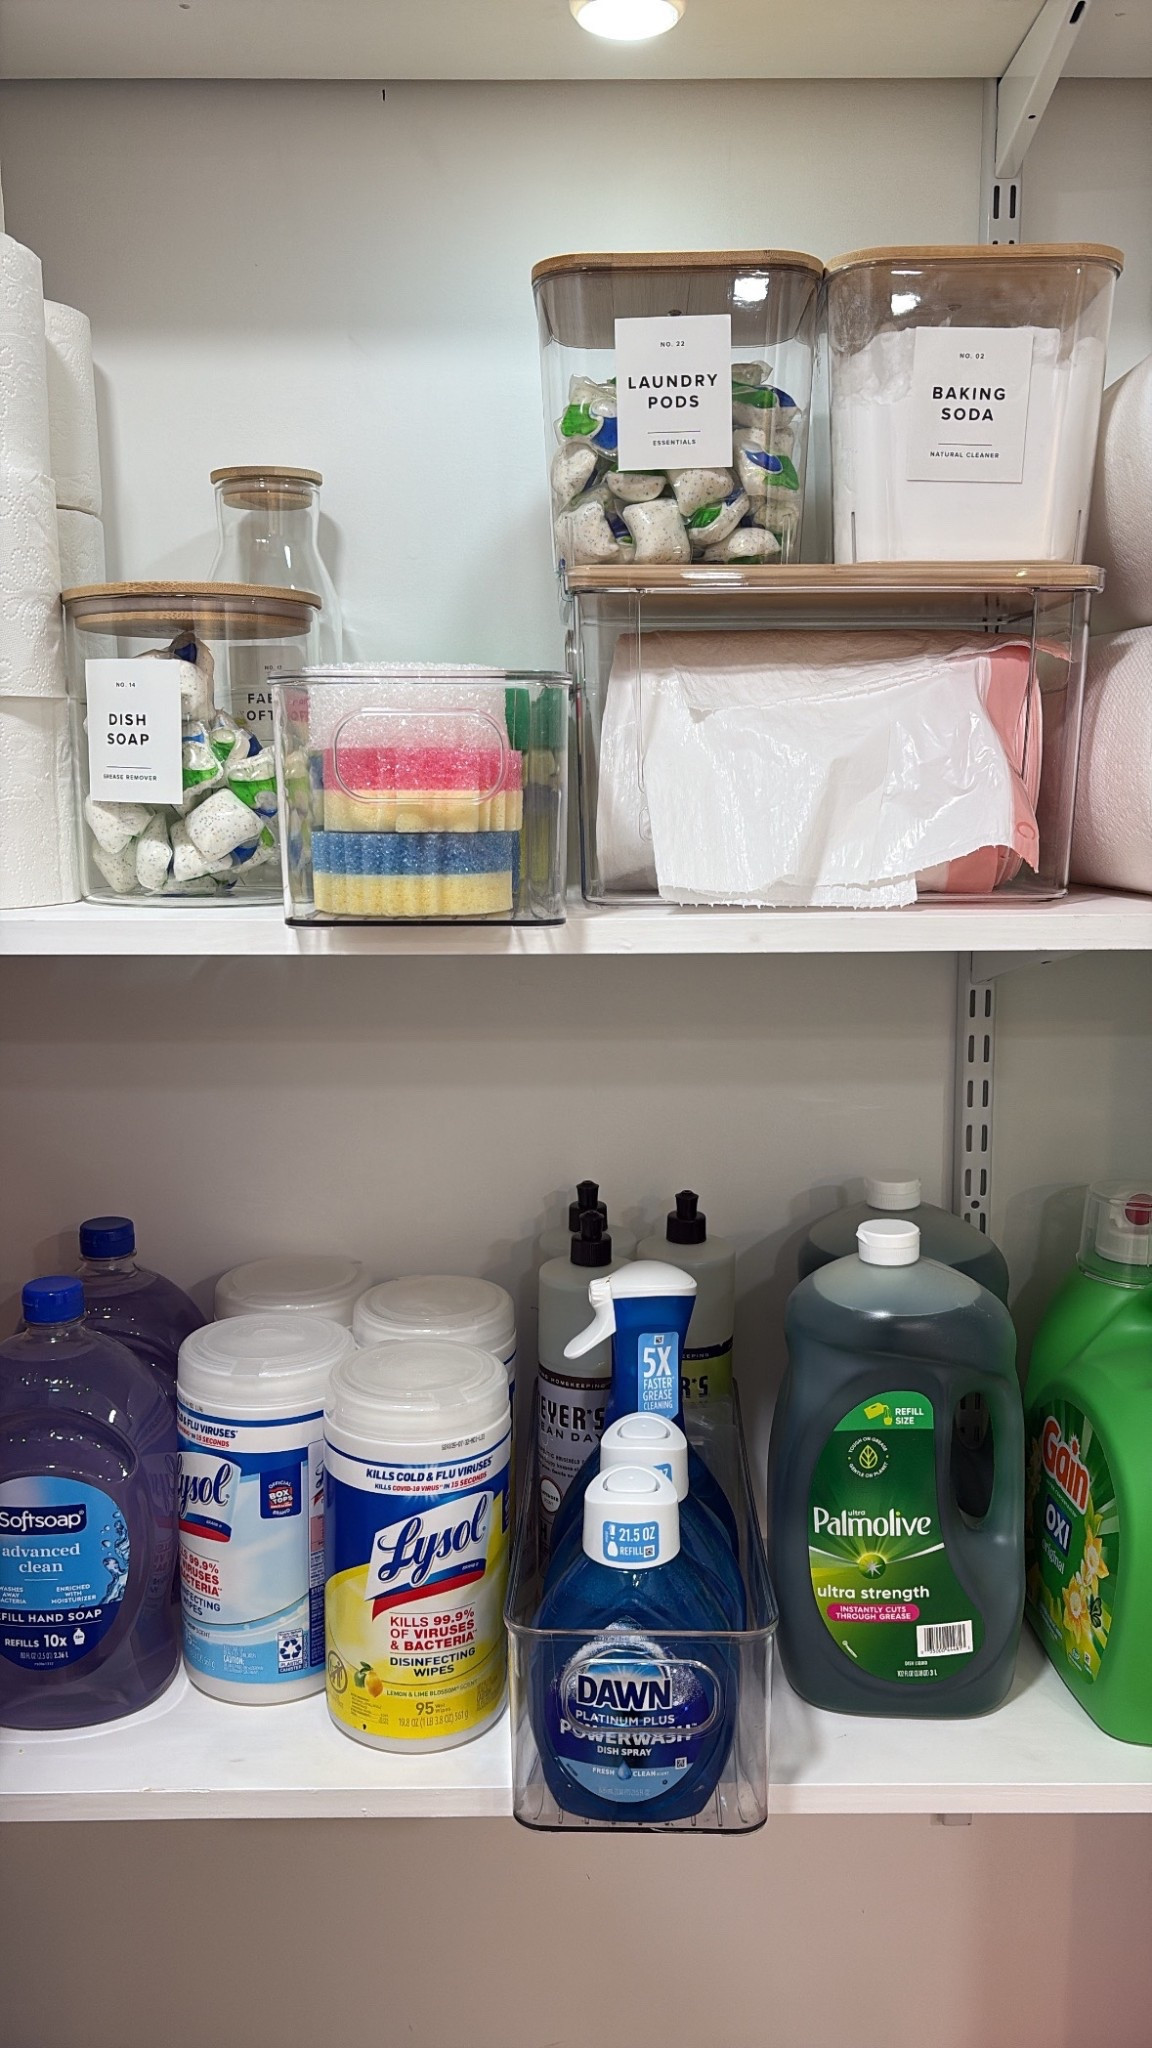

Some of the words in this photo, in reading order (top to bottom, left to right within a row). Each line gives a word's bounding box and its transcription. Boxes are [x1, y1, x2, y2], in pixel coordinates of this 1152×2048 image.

[628, 374, 718, 389] LAUNDRY
[932, 386, 1006, 401] BAKING
[648, 395, 700, 409] PODS
[941, 408, 994, 421] SODA
[108, 713, 147, 726] DISH
[107, 733, 150, 746] SOAP
[642, 1346, 671, 1377] 5X
[643, 1378, 672, 1388] FASTER
[643, 1390, 672, 1400] GREASE
[644, 1400, 673, 1410] CLEANING
[895, 1408, 924, 1416] REFILL
[895, 1417, 914, 1425] SIZE
[187, 1419, 200, 1431] FLU
[200, 1424, 236, 1438] VIRUSES
[203, 1436, 229, 1447] SECONDS
[848, 1438, 862, 1452] TOUGH
[872, 1437, 888, 1451] GREASE
[366, 1469, 394, 1480] KILLS
[397, 1472, 424, 1482] COLD
[426, 1472, 433, 1481] &
[436, 1469, 456, 1480] FLU
[458, 1458, 492, 1476] VIRUSES
[849, 1463, 864, 1477] GENTLE
[873, 1461, 888, 1476] PLANET
[1043, 1416, 1090, 1514] Gain
[268, 1480, 291, 1488] OFFICIAL
[460, 1472, 487, 1486] SECONDS
[269, 1489, 289, 1500] BOX
[272, 1496, 293, 1504] TOPS
[814, 1506, 932, 1536] Palmolive
[1046, 1504, 1069, 1550] OXI
[378, 1494, 488, 1584] Lysol
[619, 1528, 640, 1542] 21.5
[643, 1526, 655, 1541] OZ
[2, 1543, 80, 1558] advanced
[620, 1546, 644, 1556] REFILL
[18, 1561, 64, 1573] clean
[189, 1554, 219, 1574] 99.9%
[56, 1584, 90, 1592] ENRICHED
[818, 1585, 855, 1599] ultra
[861, 1586, 930, 1602] strength
[51, 1595, 96, 1604] MOISTURIZER
[28, 1614, 64, 1622] HAND
[68, 1609, 102, 1621] SOAP
[390, 1616, 428, 1627] KILLS
[434, 1608, 474, 1625] 99.9%
[836, 1612, 876, 1620] THROUGH
[390, 1628, 410, 1638] OF
[414, 1618, 474, 1638] VIRUSES
[4, 1638, 40, 1647] REFILLS
[44, 1634, 68, 1647] 10x
[390, 1640, 399, 1650] &
[404, 1632, 474, 1651] BACTERIA
[390, 1647, 476, 1666] DISINFECTING
[414, 1664, 454, 1677] WIPES
[577, 1674, 672, 1711] DAWN
[416, 1701, 434, 1716] 95
[411, 1719, 419, 1727] OZ
[426, 1717, 433, 1726] LB
[435, 1716, 444, 1725] 3.8
[576, 1710, 638, 1726] PLATINUM
[643, 1714, 675, 1726] PLUS
[597, 1745, 619, 1755] DISH
[621, 1748, 652, 1756] SPRAY
[592, 1767, 615, 1776] FRESH
[633, 1769, 656, 1777] CLEAN
